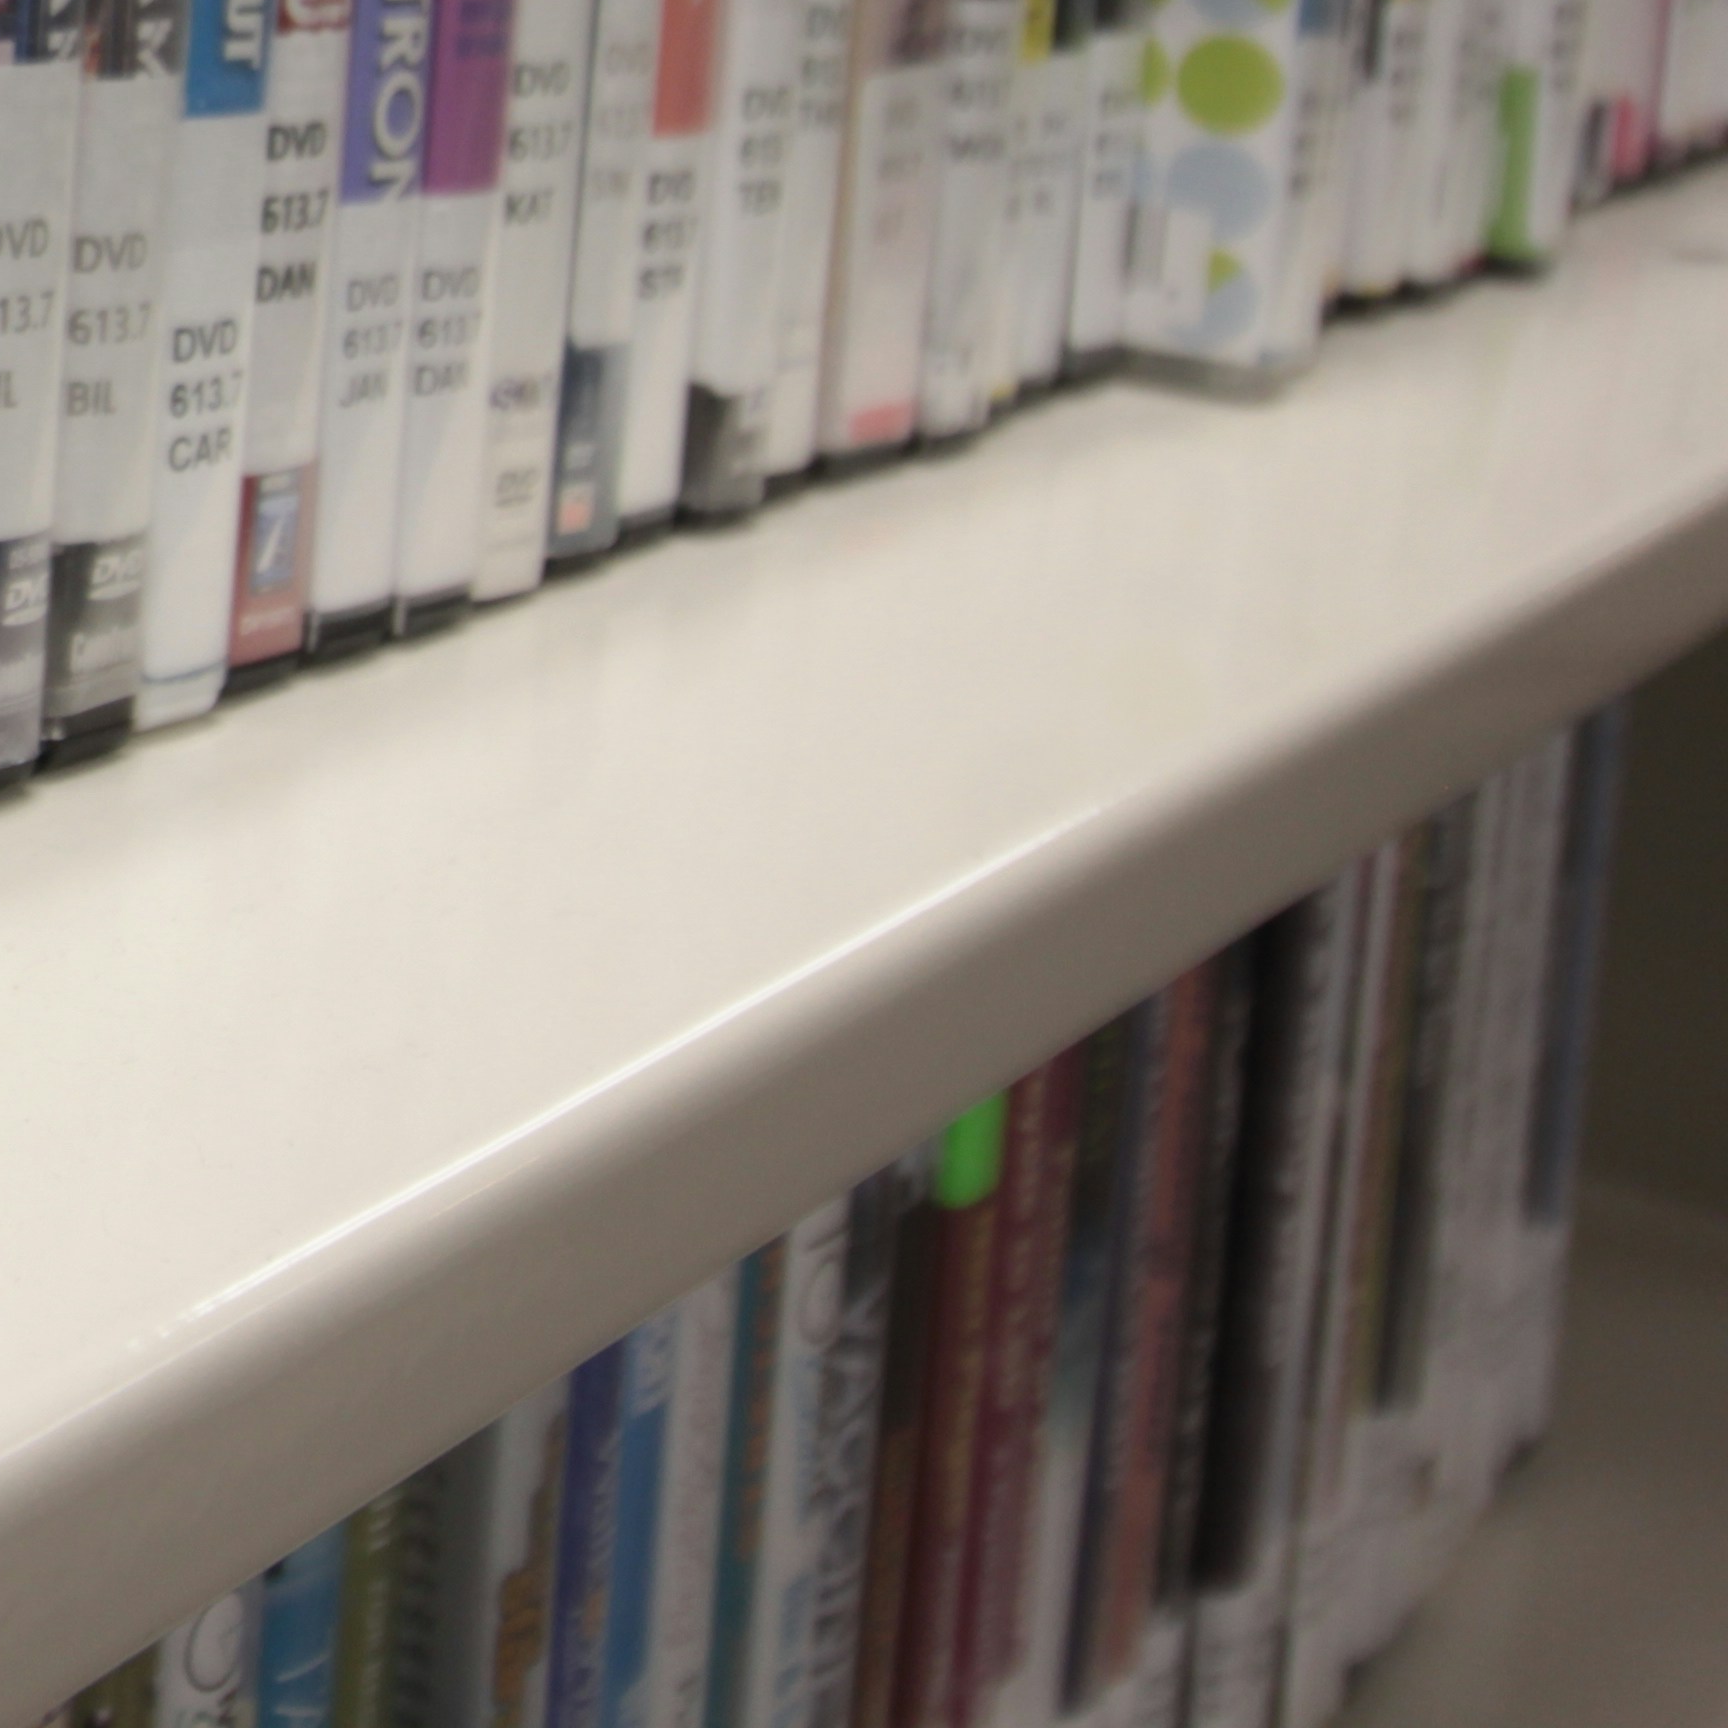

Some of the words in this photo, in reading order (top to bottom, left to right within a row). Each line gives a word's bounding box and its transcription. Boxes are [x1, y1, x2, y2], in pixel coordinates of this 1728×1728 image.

[267, 123, 326, 161] DVD
[260, 189, 329, 234] 613.7
[256, 262, 316, 303] DAN
[172, 319, 237, 364] DVD
[169, 372, 243, 419] 613.7
[168, 427, 231, 472] CAR
